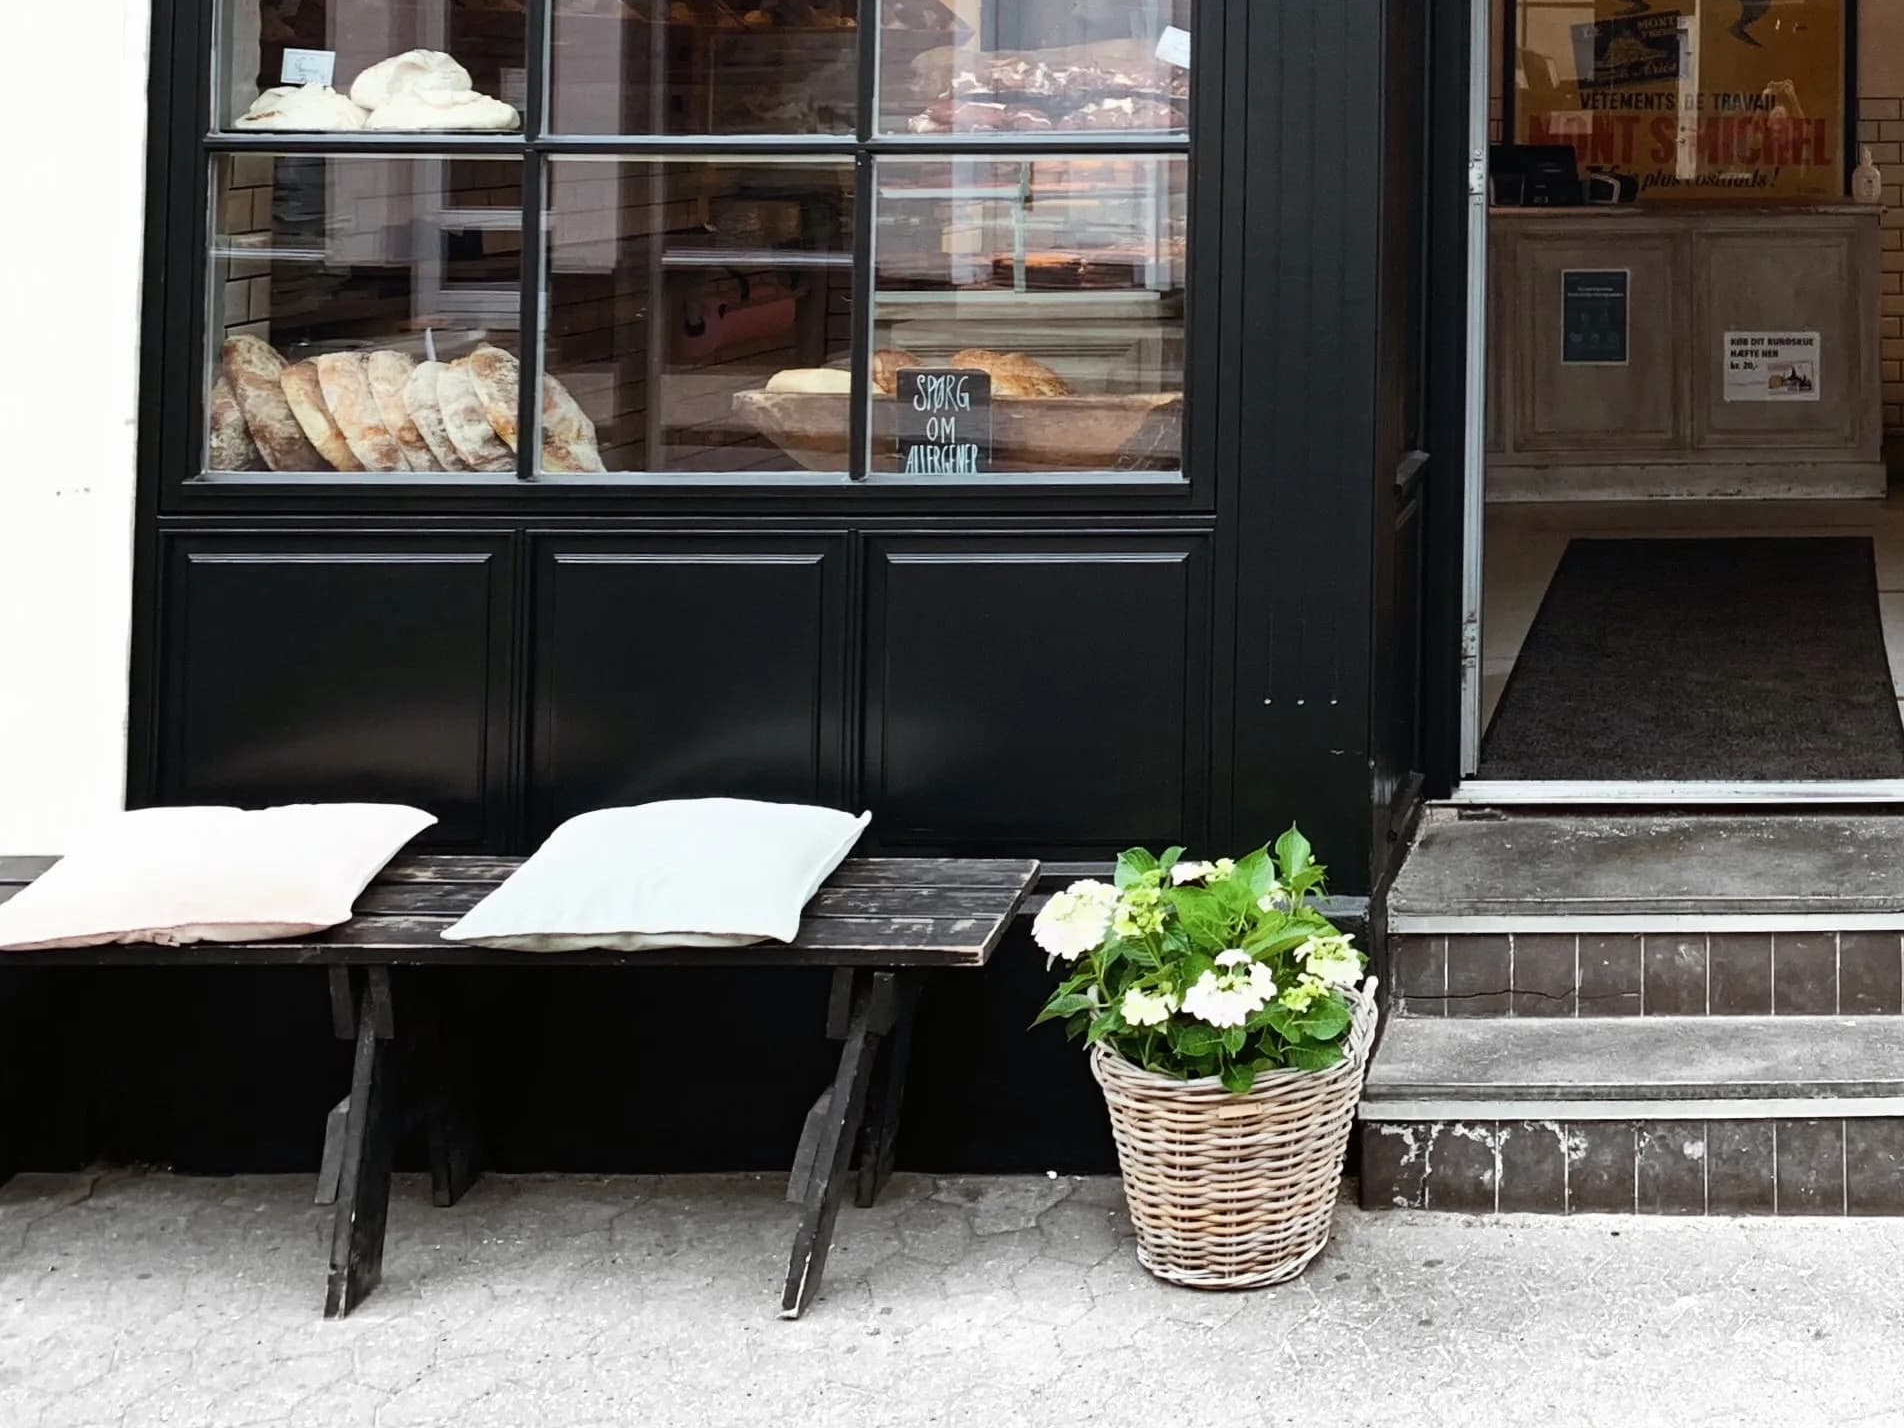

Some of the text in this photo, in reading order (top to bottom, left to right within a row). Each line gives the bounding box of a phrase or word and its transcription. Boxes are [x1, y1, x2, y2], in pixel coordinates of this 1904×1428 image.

[1684, 93, 1704, 110] DE
[1528, 115, 1641, 164] MONT
[1688, 115, 1833, 166] MICHEL
[913, 374, 971, 413] SPØRG
[926, 416, 956, 444] OM
[905, 443, 979, 474] ALLERGENER
